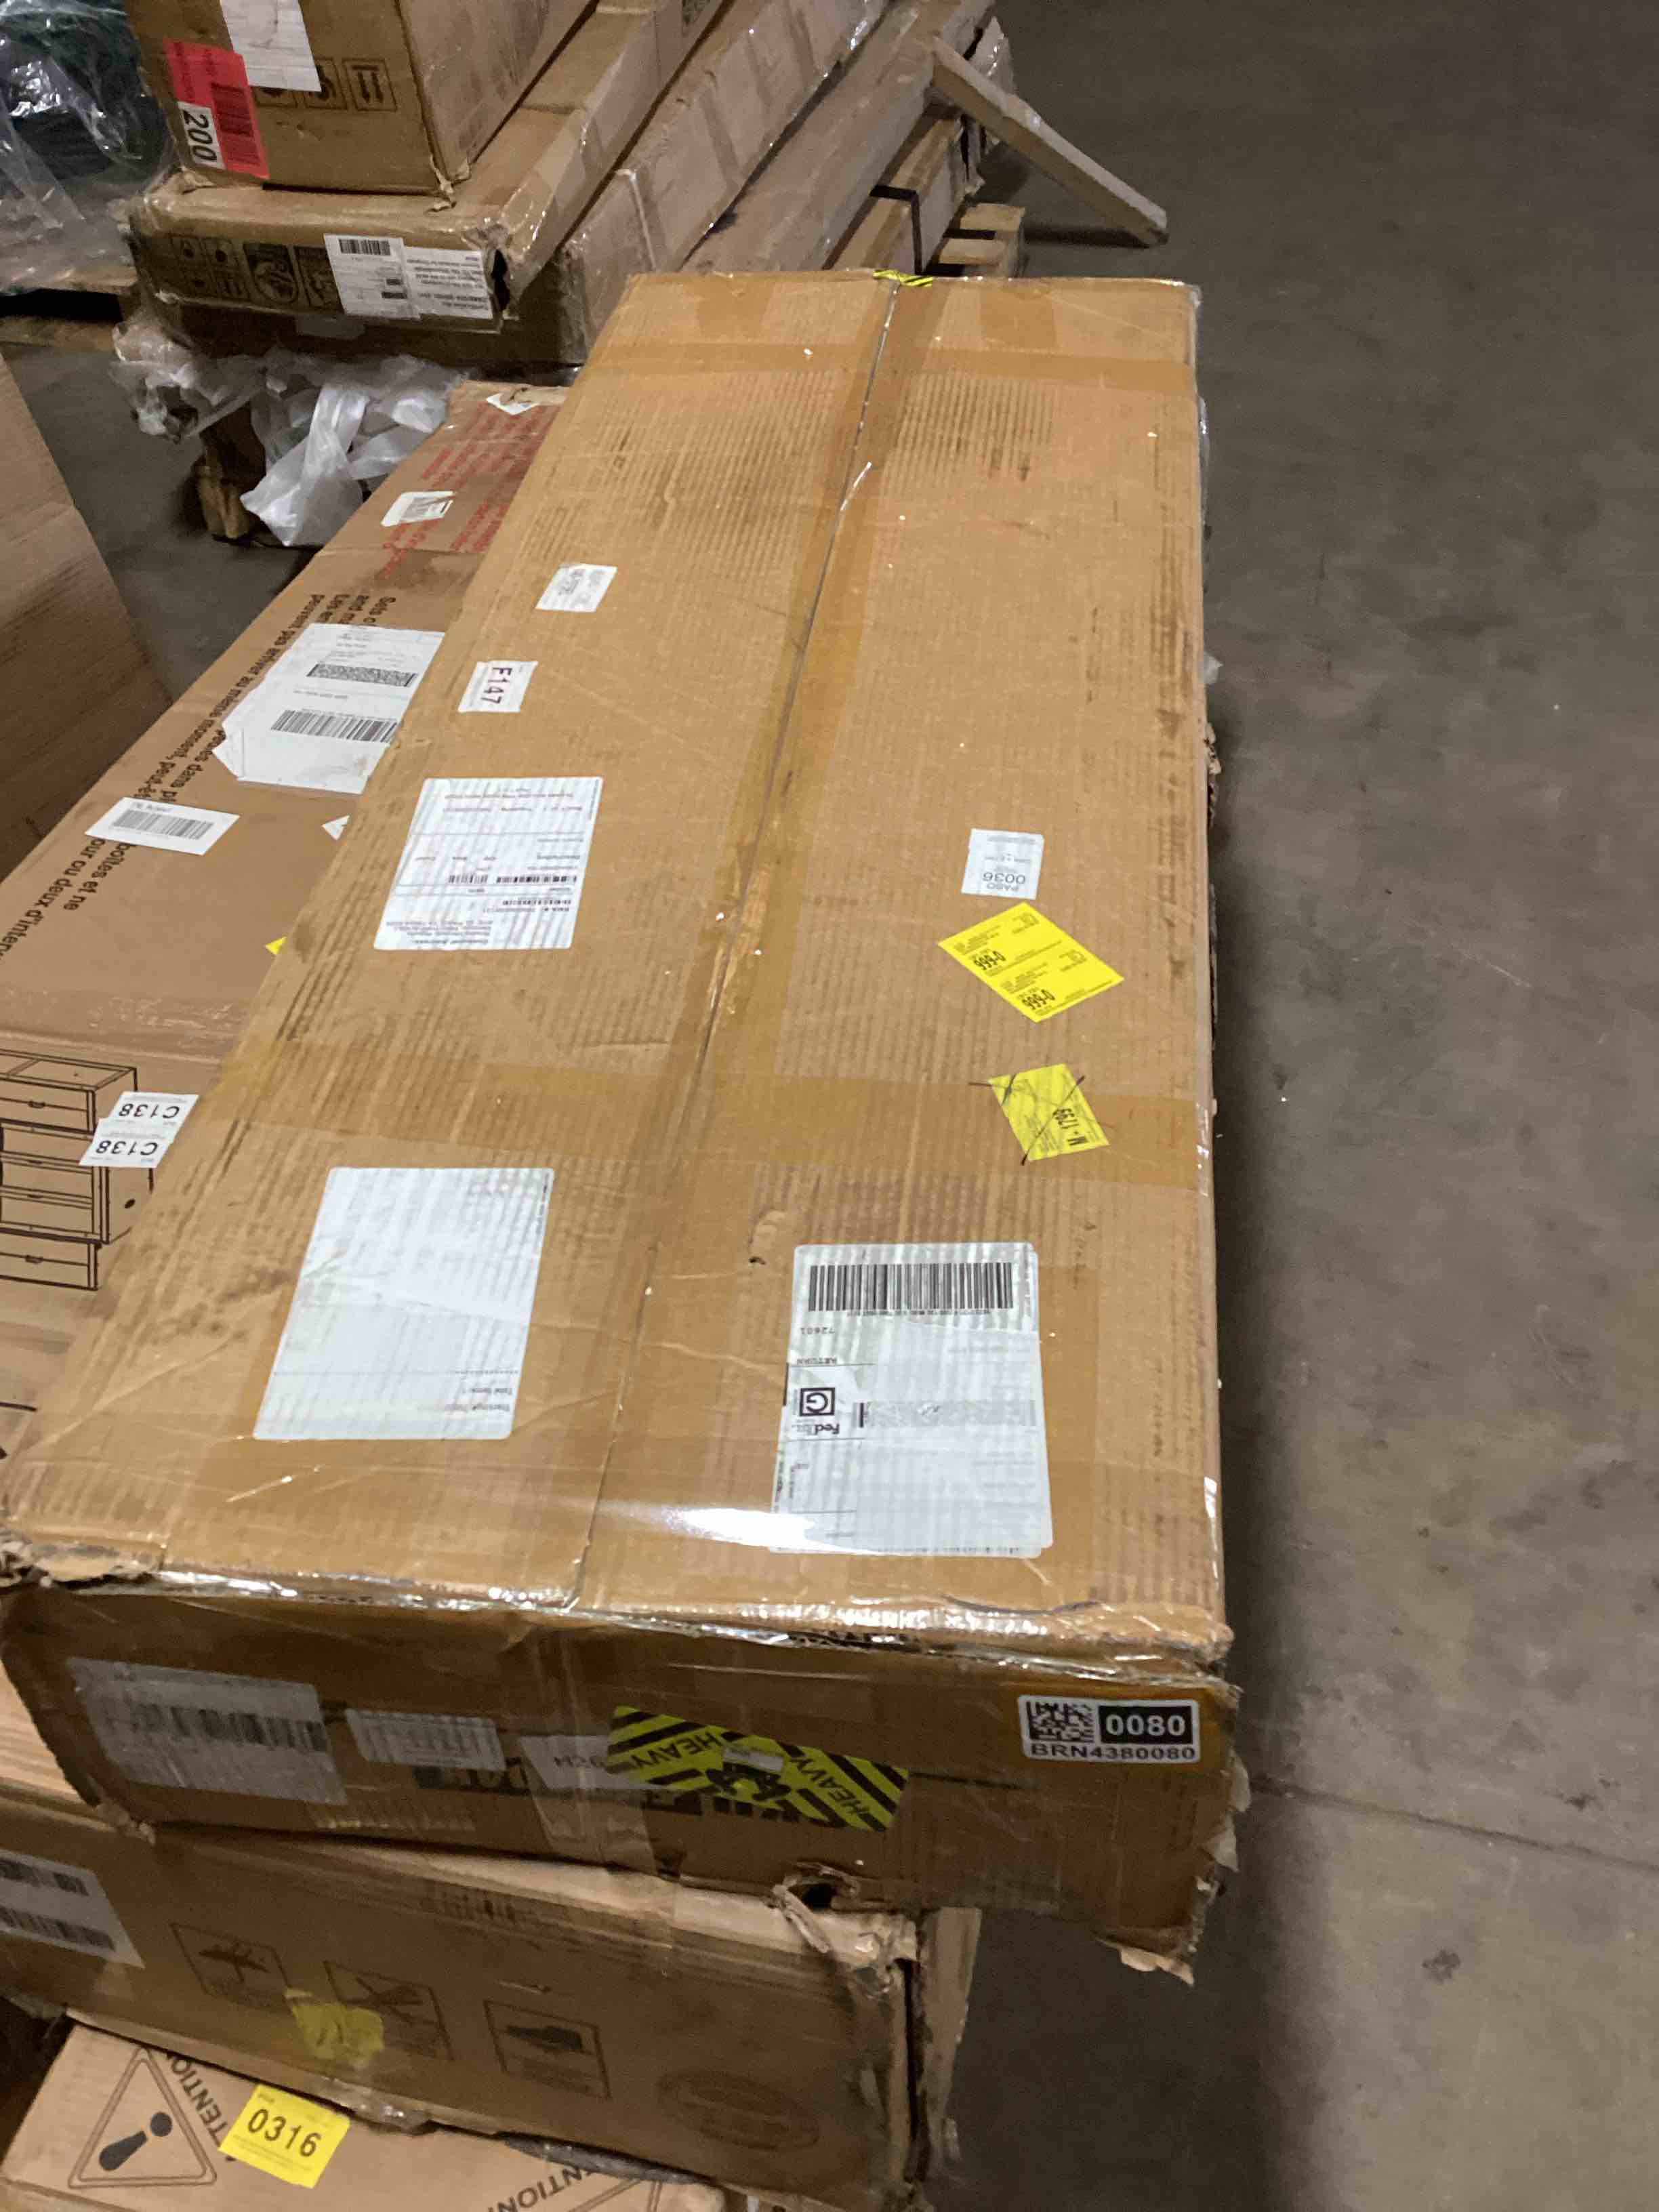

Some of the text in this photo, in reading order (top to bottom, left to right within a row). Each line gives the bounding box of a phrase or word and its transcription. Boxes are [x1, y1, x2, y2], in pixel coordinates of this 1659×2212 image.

[182, 110, 219, 163] 200
[236, 676, 253, 687] au
[480, 666, 513, 704] F147
[81, 838, 106, 859] our
[64, 860, 87, 876] ou
[77, 881, 99, 893] et
[983, 872, 1026, 884] 0036
[35, 878, 73, 908] deux
[63, 895, 87, 911] ne
[118, 1103, 180, 1119] C138
[96, 1140, 159, 1155] C138
[1105, 1714, 1187, 1736] 0080
[631, 1732, 722, 1769] HEAVY
[1030, 1743, 1196, 1760] BRN4380080
[789, 1755, 871, 1816] HEAVY
[247, 2108, 323, 2158] 0316
